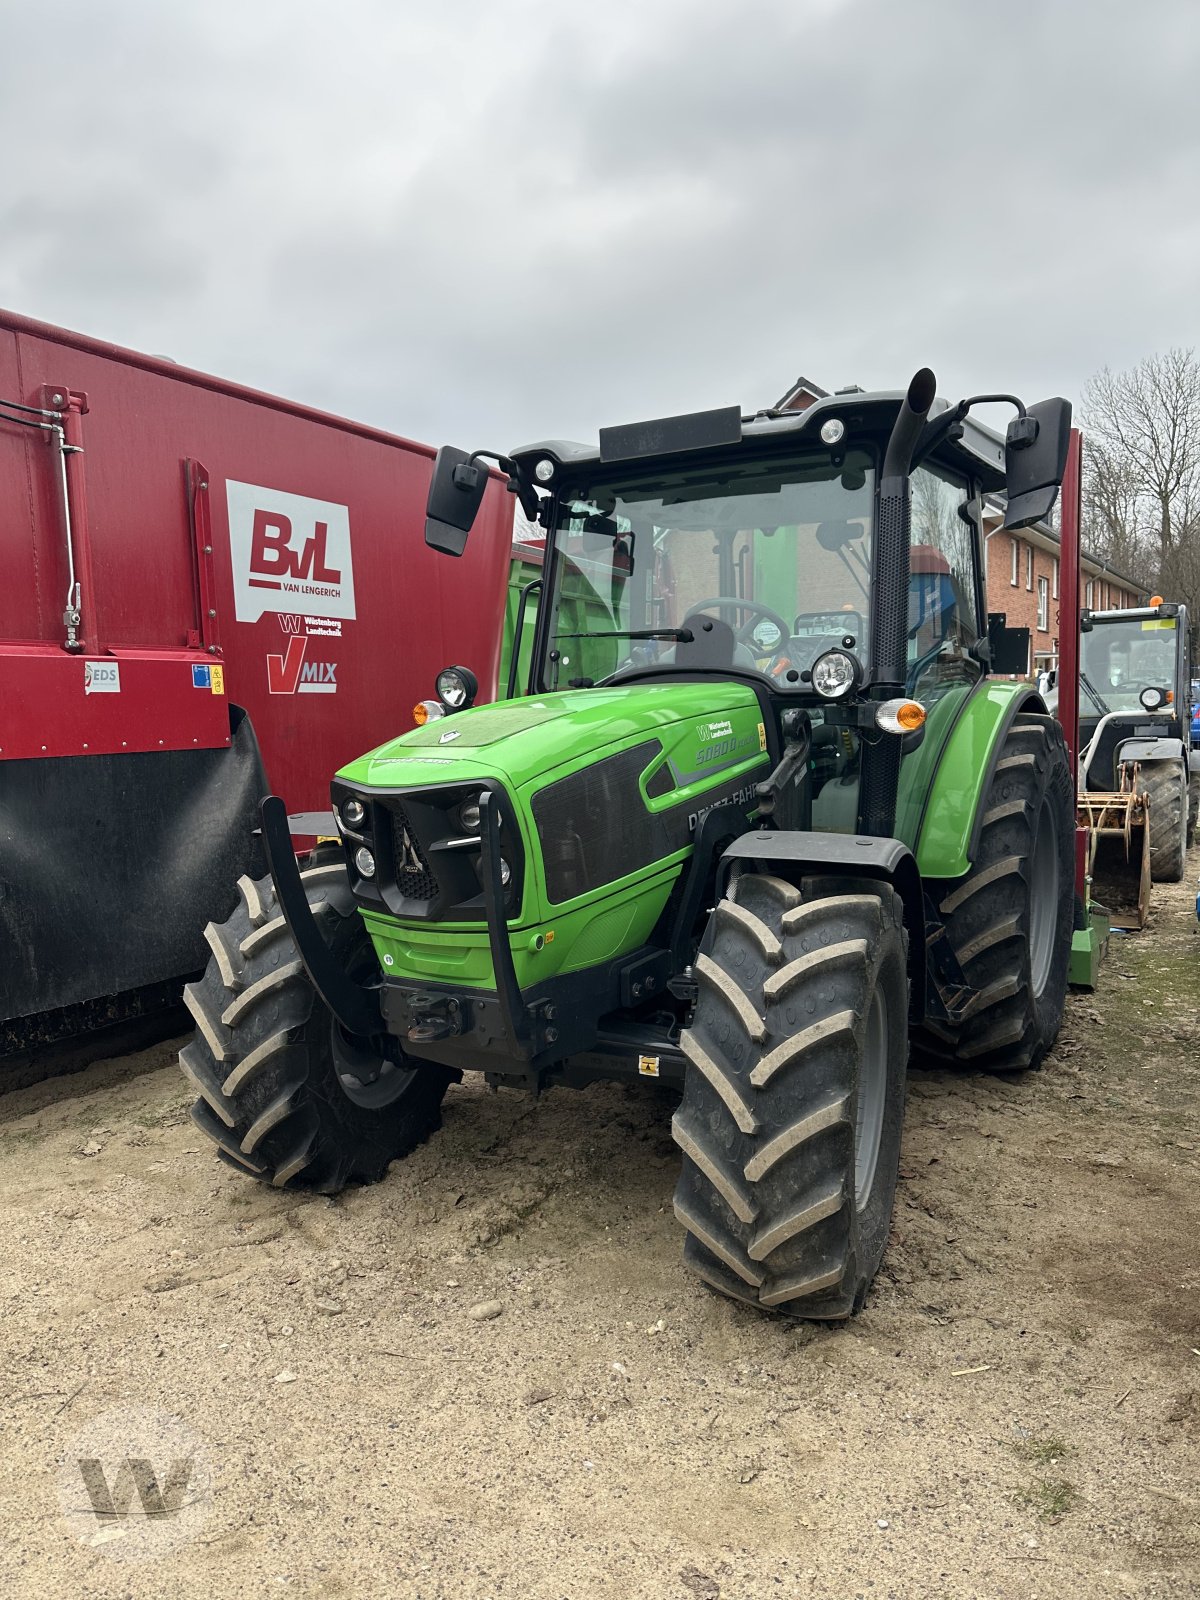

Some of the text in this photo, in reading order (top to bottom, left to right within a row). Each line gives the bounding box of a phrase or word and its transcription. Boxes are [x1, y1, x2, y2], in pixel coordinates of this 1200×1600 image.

[283, 582, 341, 598] VAN LENGERICH
[304, 616, 342, 629] Wüstenberg
[305, 626, 342, 637] Landtechnik
[93, 669, 116, 681] EDS
[300, 661, 337, 682] MIX
